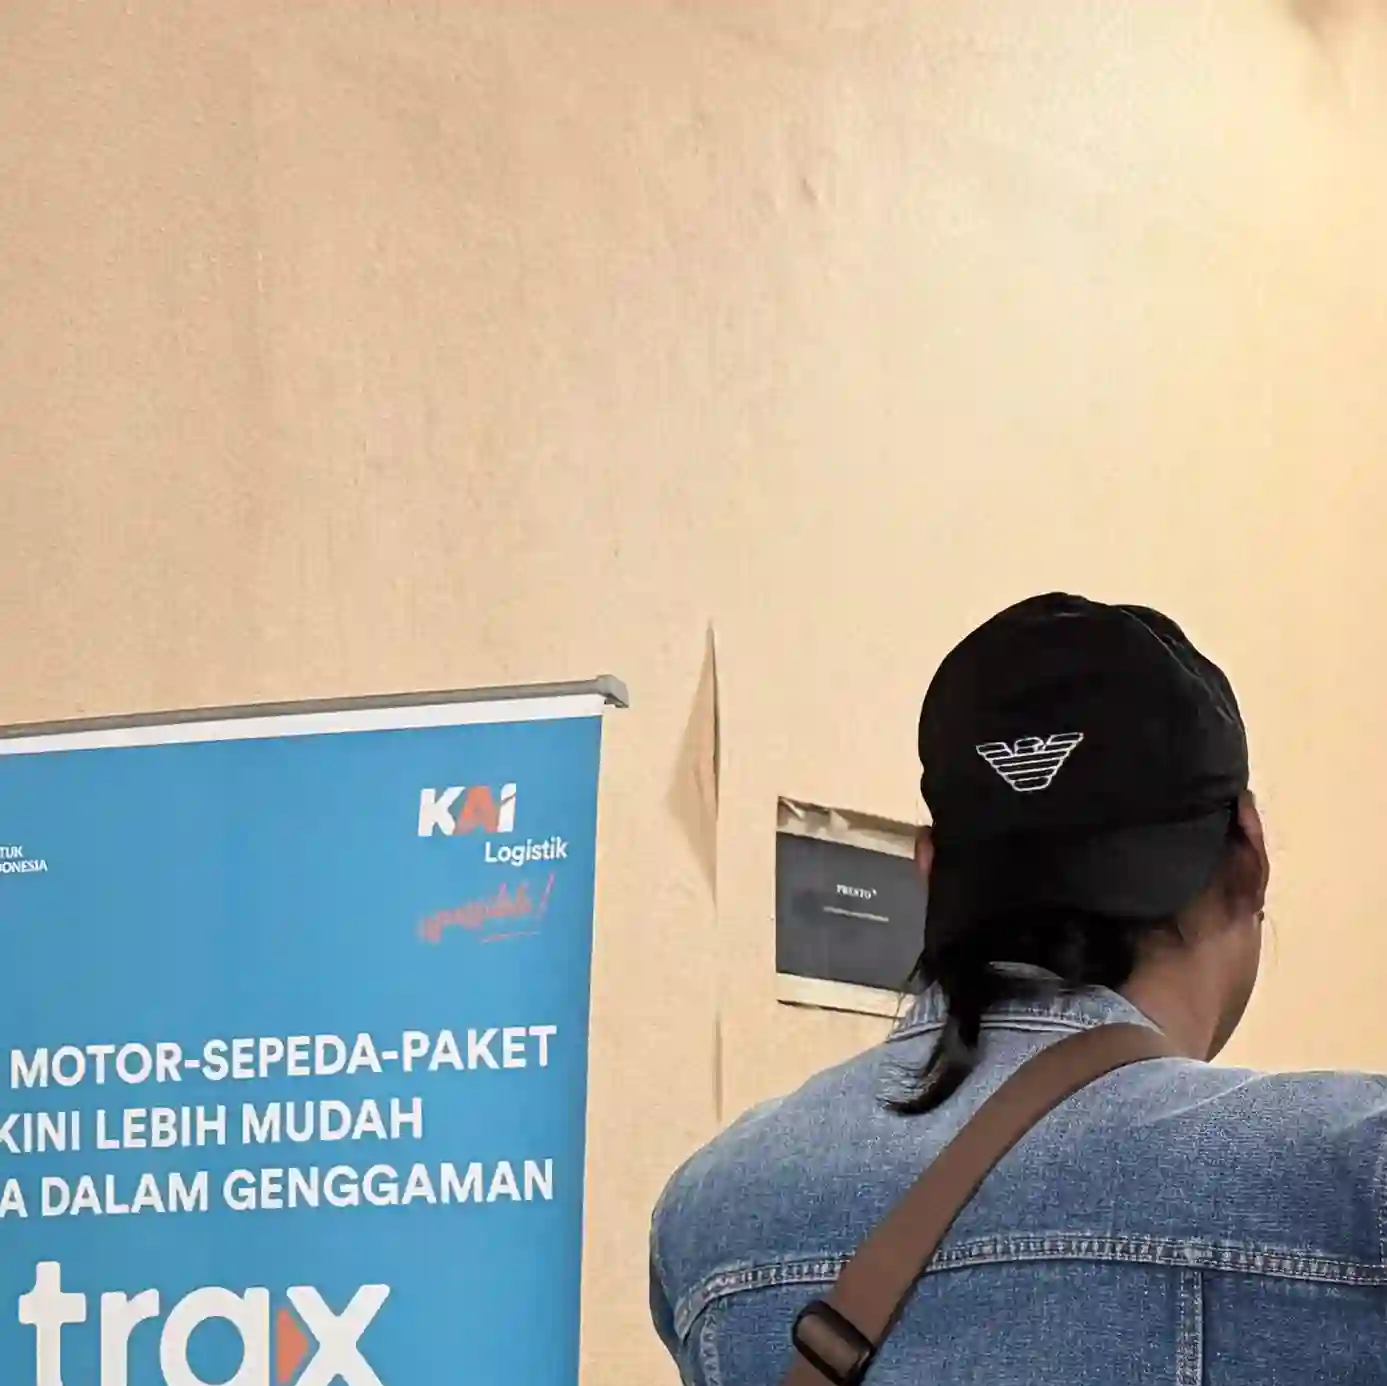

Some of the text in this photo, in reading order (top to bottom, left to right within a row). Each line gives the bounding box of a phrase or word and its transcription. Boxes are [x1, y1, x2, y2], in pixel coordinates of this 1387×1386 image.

[418, 783, 517, 837] KAI
[0, 859, 48, 873] ONESIA
[484, 836, 569, 867] Logistik
[10, 1025, 558, 1090] MOTOR-SEPEDA-PAKET
[96, 1106, 227, 1150] LEBIH
[242, 1097, 423, 1145] MUDAH
[41, 1171, 208, 1217] DALAM
[223, 1159, 554, 1211] GENGGAMAN
